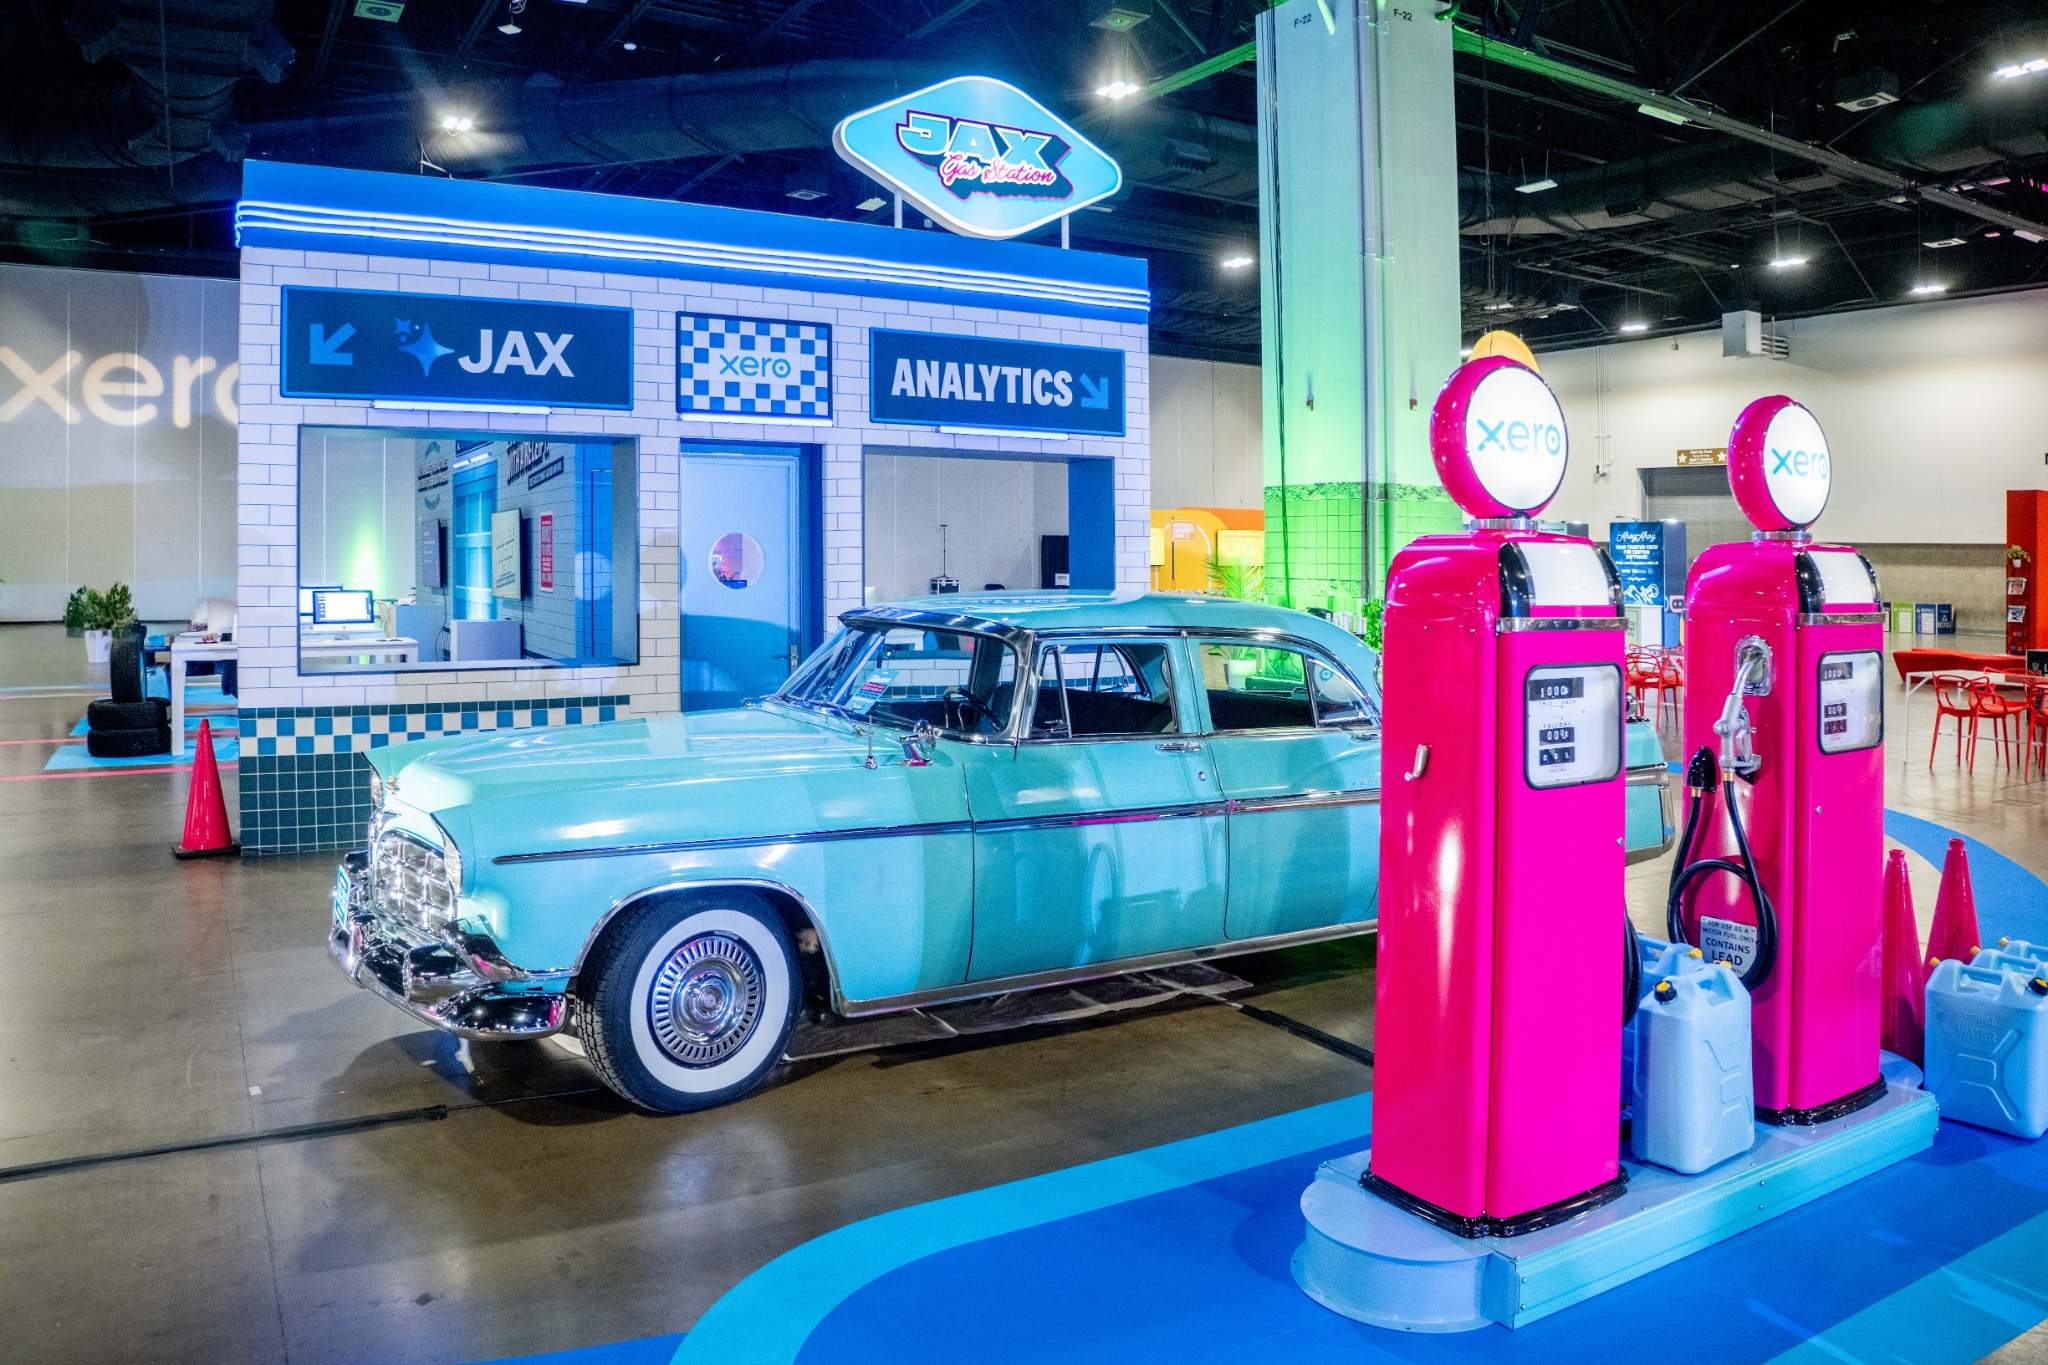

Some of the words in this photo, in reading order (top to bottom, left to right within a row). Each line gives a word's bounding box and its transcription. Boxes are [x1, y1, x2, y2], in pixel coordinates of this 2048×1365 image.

[1293, 13, 1312, 28] F-22
[1393, 8, 1413, 22] F-22
[897, 109, 1056, 172] JAX
[941, 153, 979, 184] Gas
[983, 159, 1056, 184] Station
[458, 328, 575, 378] JAX
[719, 354, 791, 379] xero
[890, 357, 1074, 408] ANALYTICS
[1476, 418, 1562, 456] xero
[1771, 447, 1829, 480] xero
[1703, 927, 1722, 936] MOTOR
[1724, 931, 1738, 940] FUEL
[1740, 935, 1755, 943] ONLY
[1705, 937, 1750, 955] CONTAINS
[1711, 950, 1743, 966] LEAD
